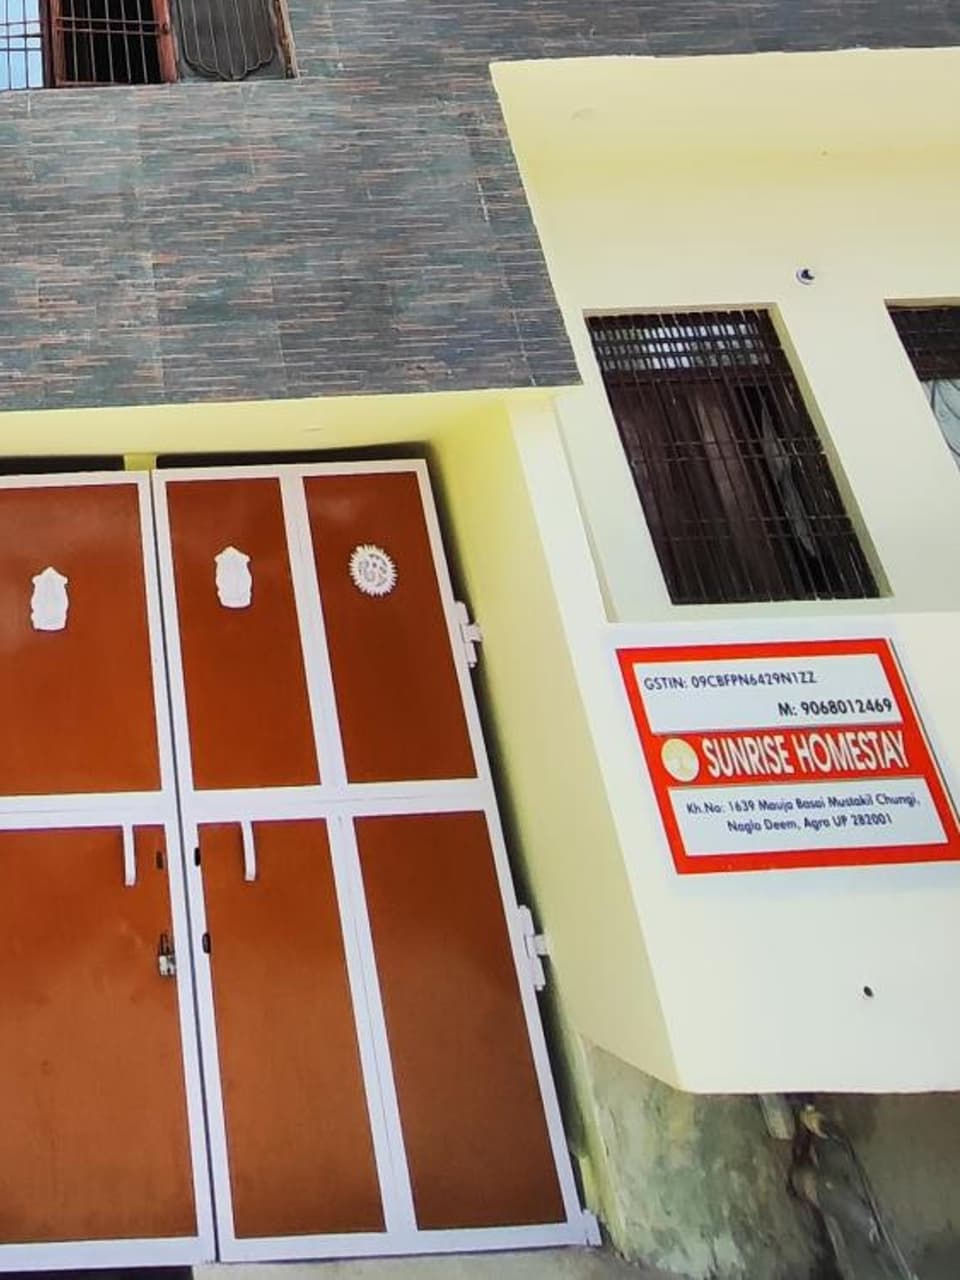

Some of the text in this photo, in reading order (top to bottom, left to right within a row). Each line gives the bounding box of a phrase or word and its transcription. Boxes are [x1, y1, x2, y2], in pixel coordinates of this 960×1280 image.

[643, 676, 688, 691] GSTIN:
[778, 698, 892, 716] M: 9068012469
[701, 729, 910, 778] SUNRISE HOMESTAY
[803, 816, 831, 831] Agra
[831, 814, 848, 827] UP
[850, 812, 893, 826] 282001
